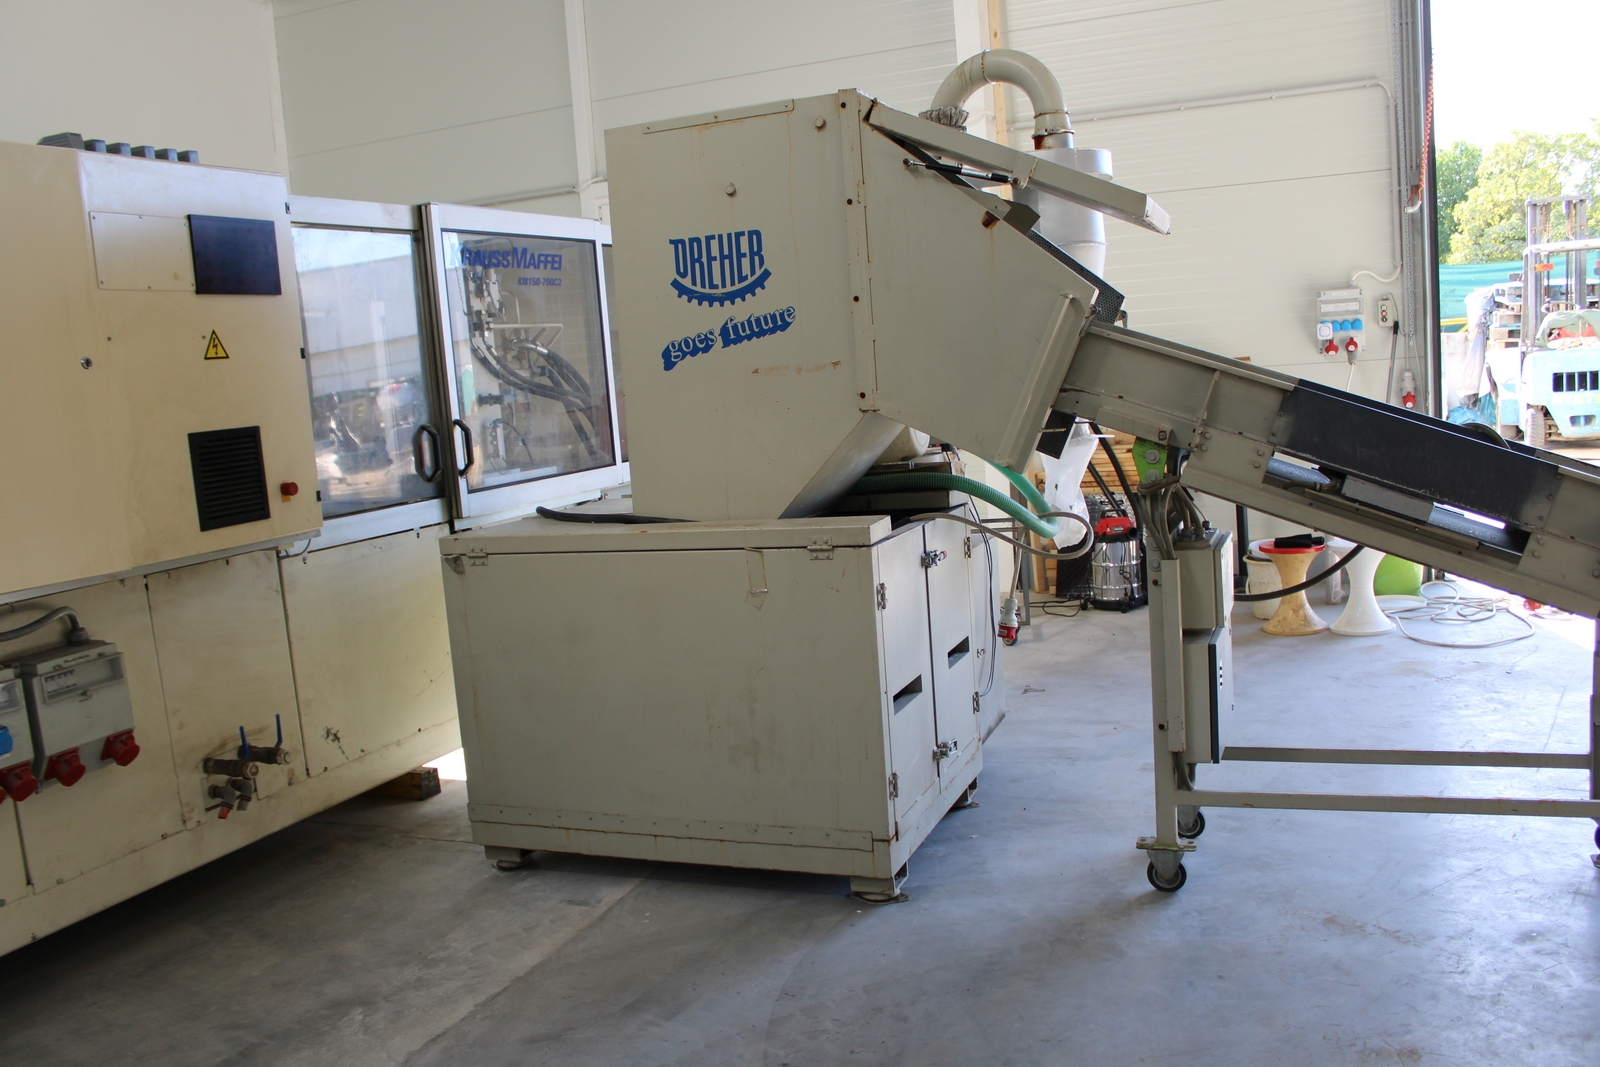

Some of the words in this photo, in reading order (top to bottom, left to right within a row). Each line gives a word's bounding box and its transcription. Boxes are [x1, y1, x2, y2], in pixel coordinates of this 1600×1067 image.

[668, 229, 765, 290] DREHER
[665, 328, 718, 366] goes
[723, 305, 796, 343] future
